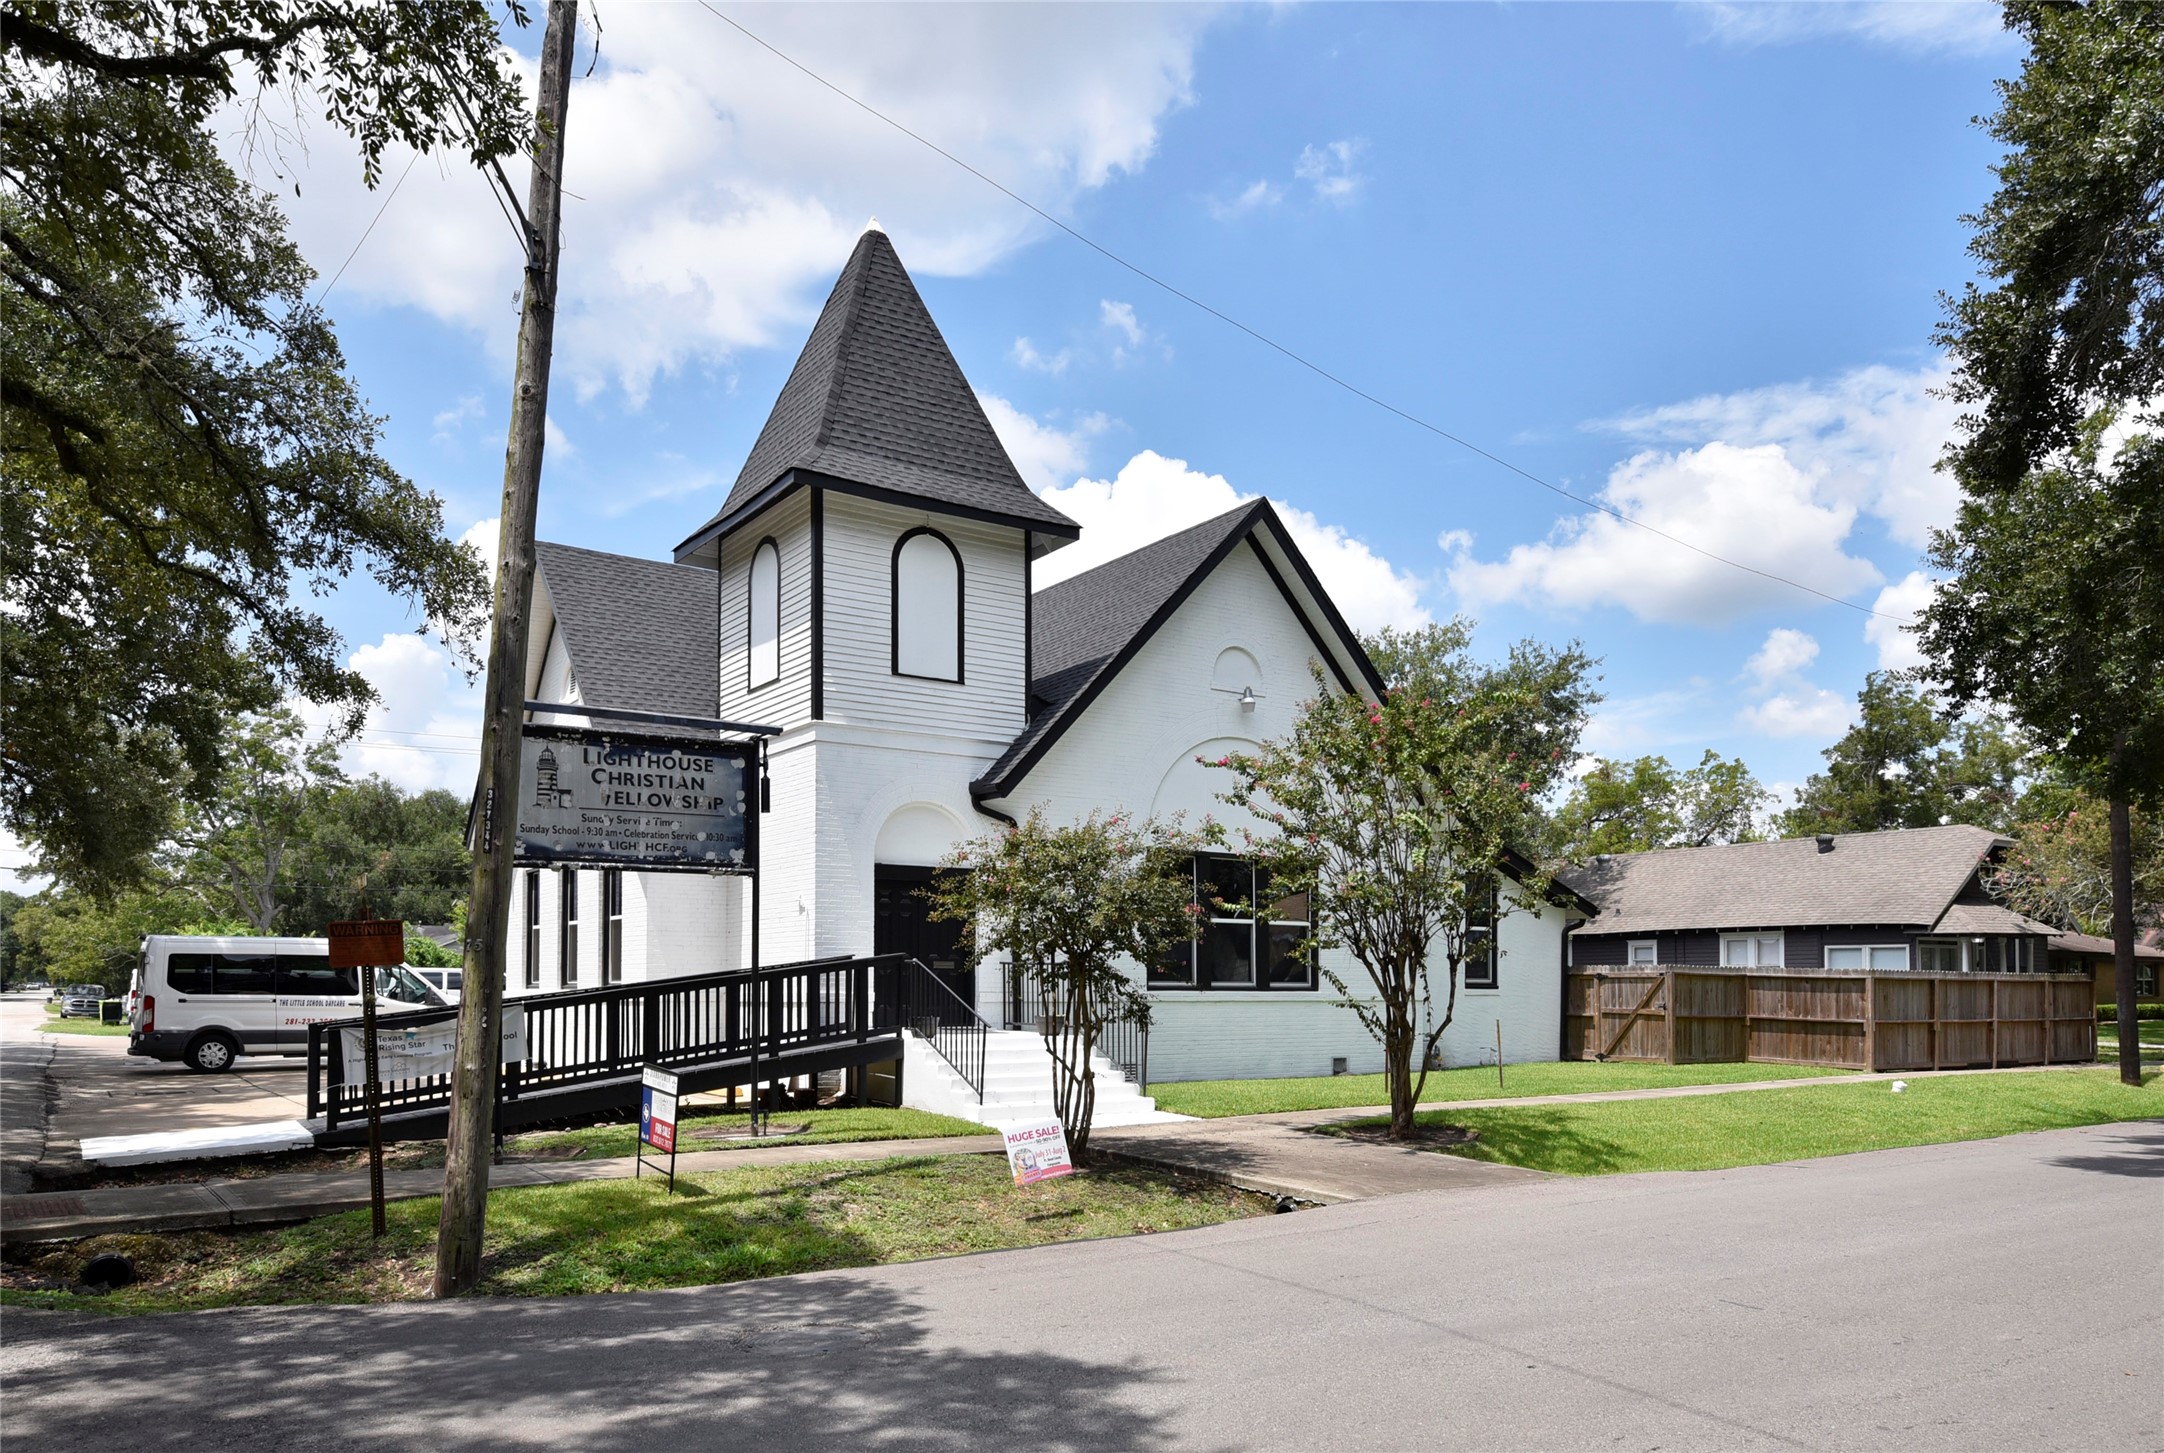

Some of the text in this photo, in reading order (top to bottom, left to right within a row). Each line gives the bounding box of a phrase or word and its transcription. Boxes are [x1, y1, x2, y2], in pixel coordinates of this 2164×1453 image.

[583, 748, 714, 773] LIGHTHOUSE
[591, 767, 705, 791] CHRISTIAN
[602, 788, 724, 810] ELLOSHIP
[581, 813, 682, 828] Sundy Servie Tim:
[520, 823, 550, 836] Sunday
[552, 825, 580, 836] School
[586, 826, 603, 837] 9:30
[624, 829, 669, 841] Celebration
[671, 831, 703, 842] Servic
[332, 923, 399, 937] WARNING
[280, 999, 346, 1007] THE LITTLE SCHOOL DAYCARE
[377, 1034, 403, 1043] Texas
[378, 1041, 426, 1052] Rising Star
[442, 1043, 455, 1051] Th
[1008, 1126, 1059, 1143] HUGE SALE!
